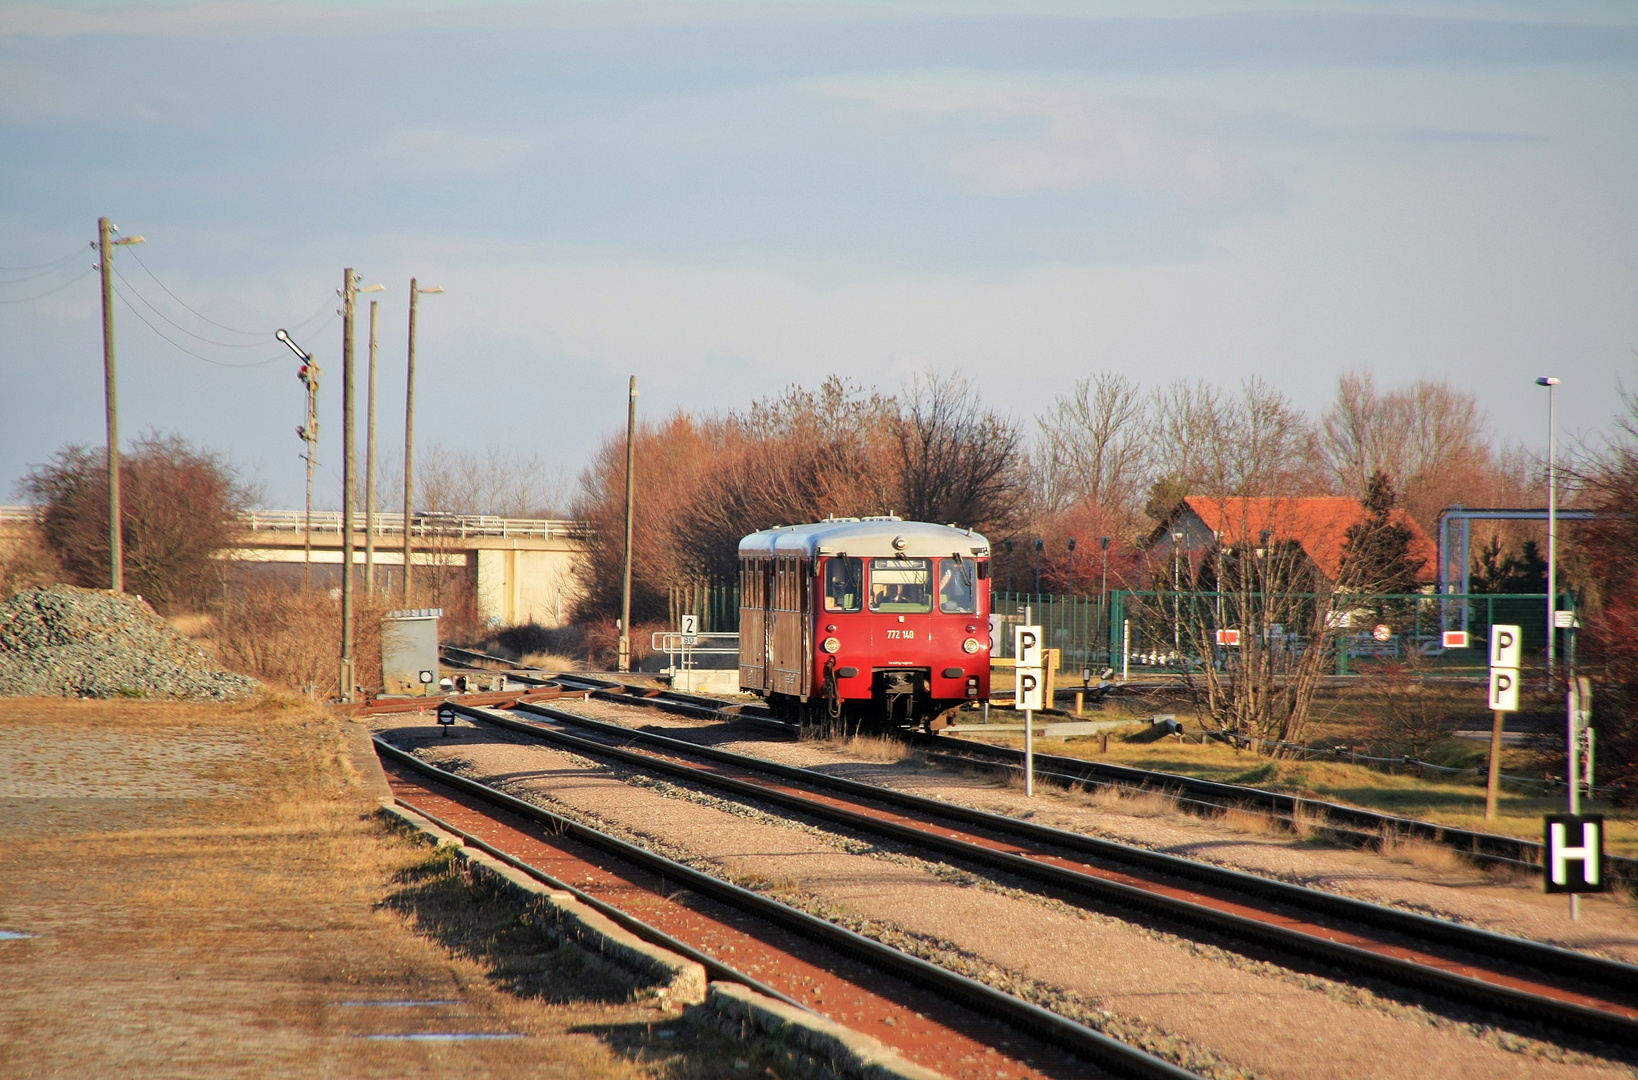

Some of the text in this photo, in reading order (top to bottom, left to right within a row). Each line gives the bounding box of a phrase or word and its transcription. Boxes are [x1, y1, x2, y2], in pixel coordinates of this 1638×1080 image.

[686, 618, 693, 633] 2
[887, 630, 914, 639] 772 140
[1020, 631, 1036, 661] P
[1496, 631, 1513, 661] P
[1020, 674, 1037, 704] P
[1494, 674, 1511, 704] P
[1551, 822, 1599, 885] H
